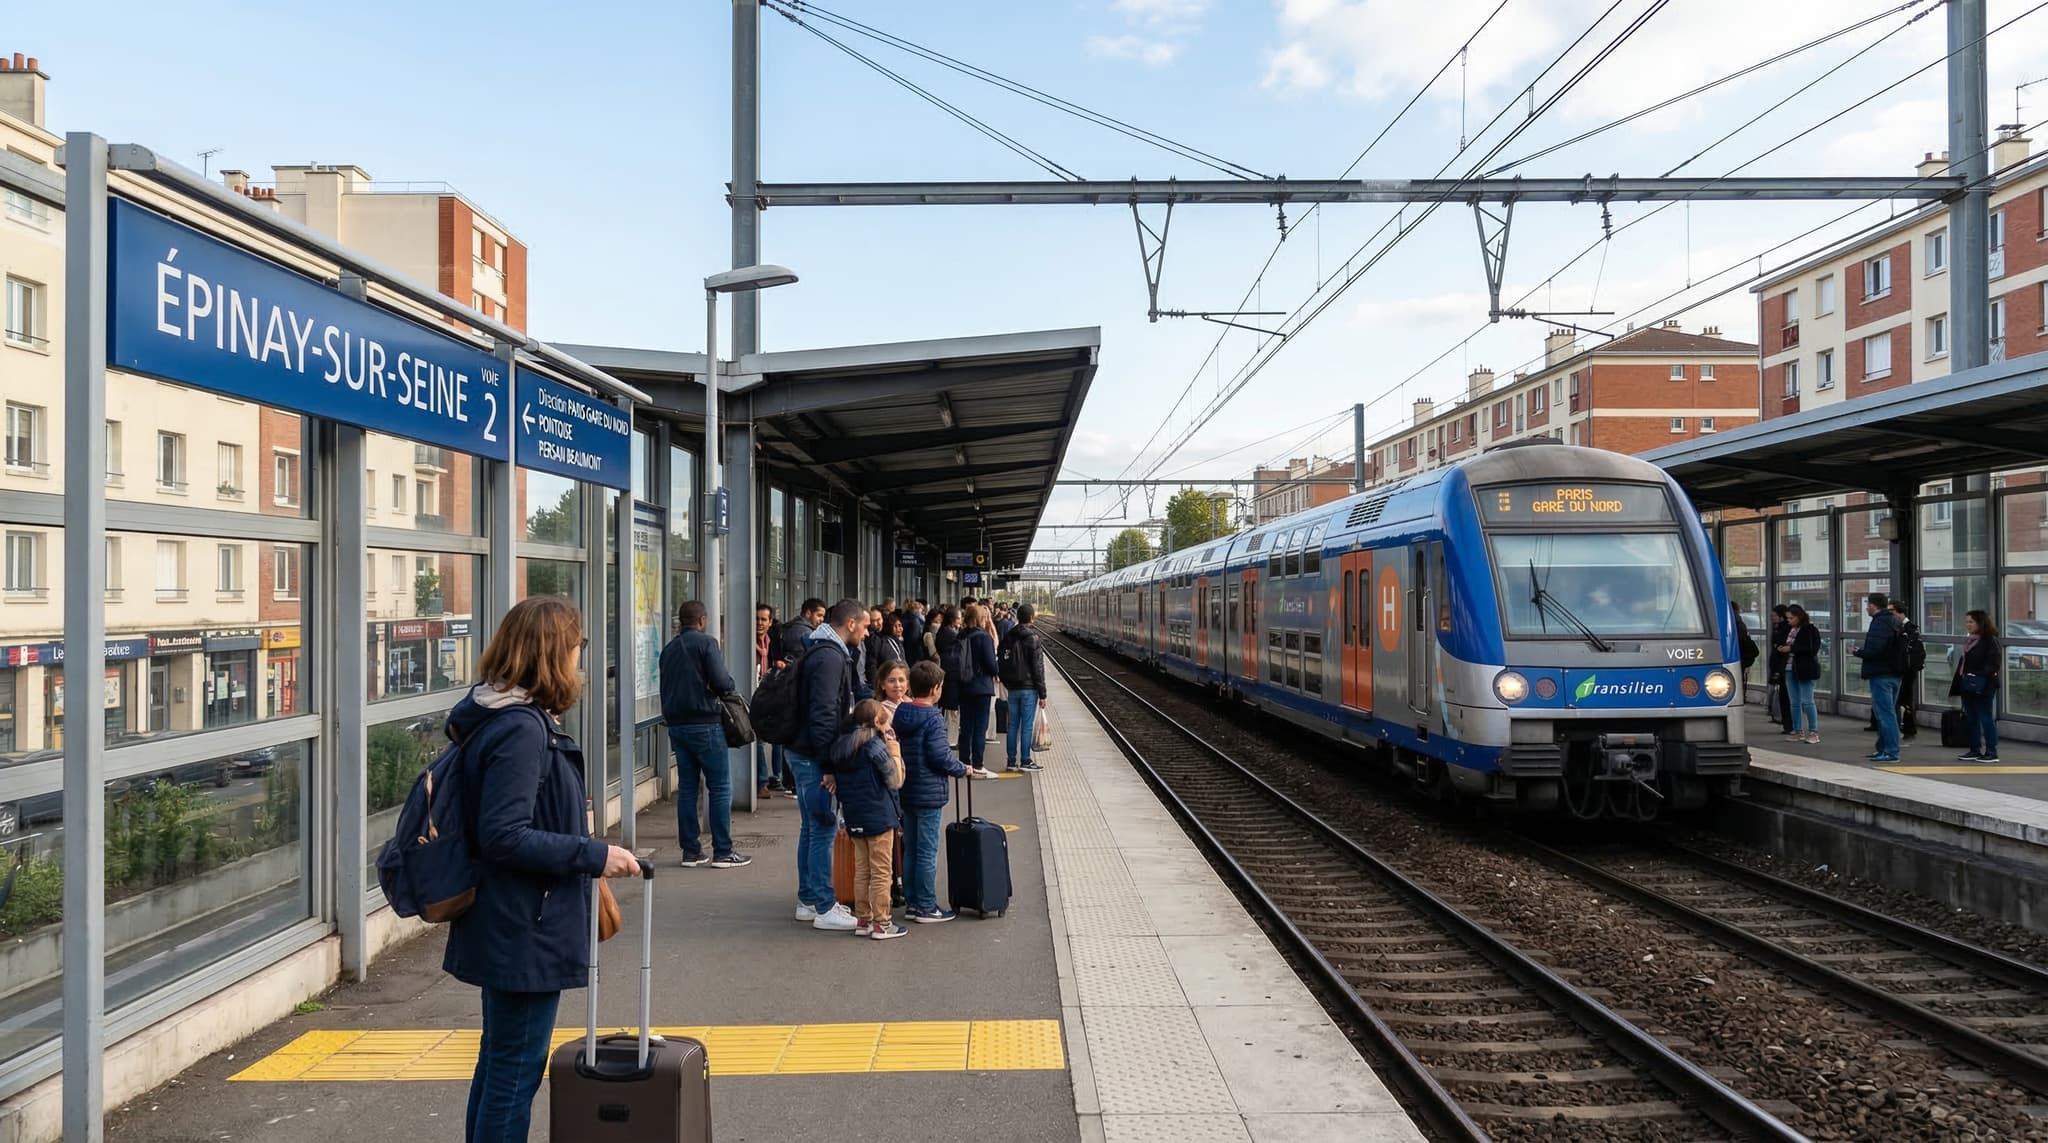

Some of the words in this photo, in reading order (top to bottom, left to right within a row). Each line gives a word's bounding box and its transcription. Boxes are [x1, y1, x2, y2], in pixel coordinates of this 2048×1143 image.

[157, 247, 468, 422] ÉPINAY-SUR-SEINE
[481, 367, 499, 387] VOIE
[483, 392, 497, 443] 2
[538, 414, 573, 441] PONTOISE
[603, 413, 612, 430] DU
[538, 440, 566, 463] PERSAN
[1556, 488, 1593, 500] PARIS
[1532, 500, 1565, 512] GARE
[1569, 500, 1586, 512] DU
[1590, 500, 1623, 512] NORD
[1383, 586, 1395, 631] H
[1666, 648, 1695, 659] VOIE
[1583, 681, 1664, 695] Transilien
